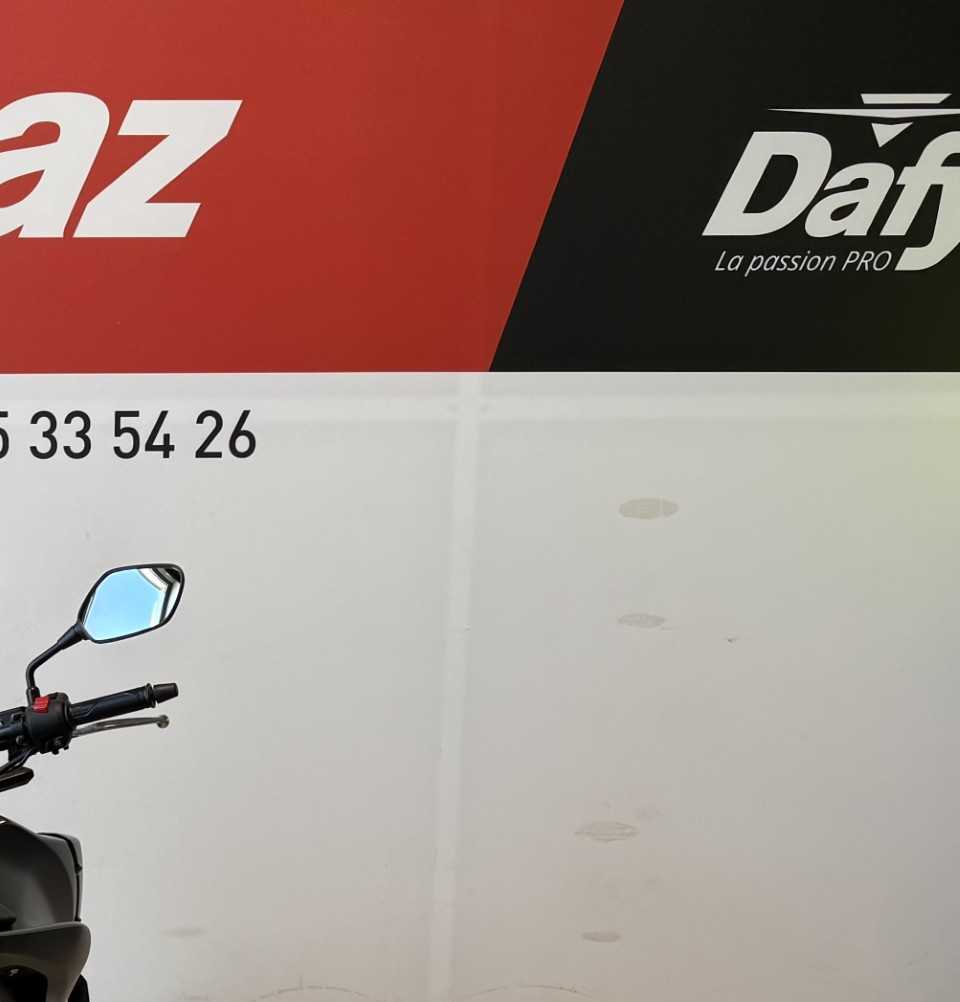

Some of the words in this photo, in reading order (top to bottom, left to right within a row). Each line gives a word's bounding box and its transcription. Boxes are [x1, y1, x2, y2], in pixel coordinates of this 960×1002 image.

[715, 251, 744, 271] La
[744, 251, 836, 277] passion
[842, 251, 892, 271] PRO
[30, 411, 92, 460] 33
[113, 411, 175, 460] 54
[195, 410, 257, 460] 26
